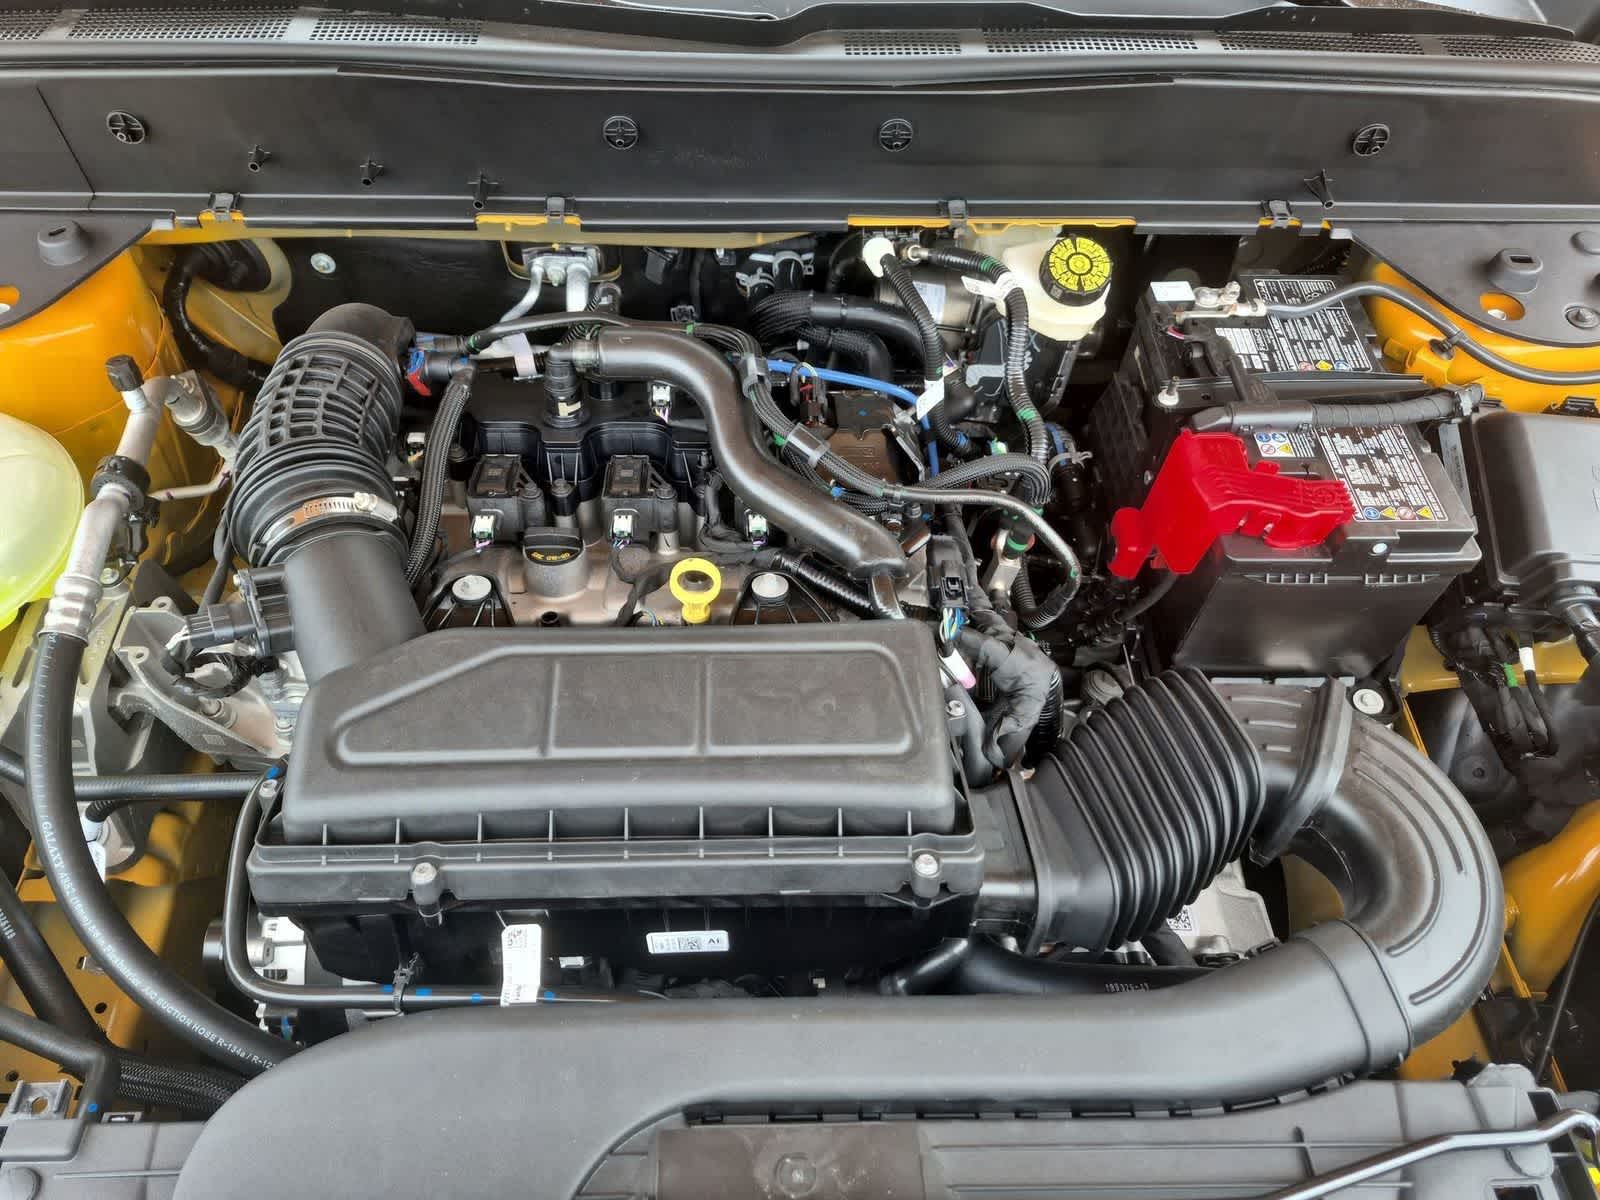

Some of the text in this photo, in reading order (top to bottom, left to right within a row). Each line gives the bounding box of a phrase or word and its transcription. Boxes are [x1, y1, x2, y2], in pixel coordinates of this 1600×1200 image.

[41, 821, 65, 869] GALAXY
[156, 997, 191, 1026] SUCTION
[191, 1023, 215, 1042] HOSE
